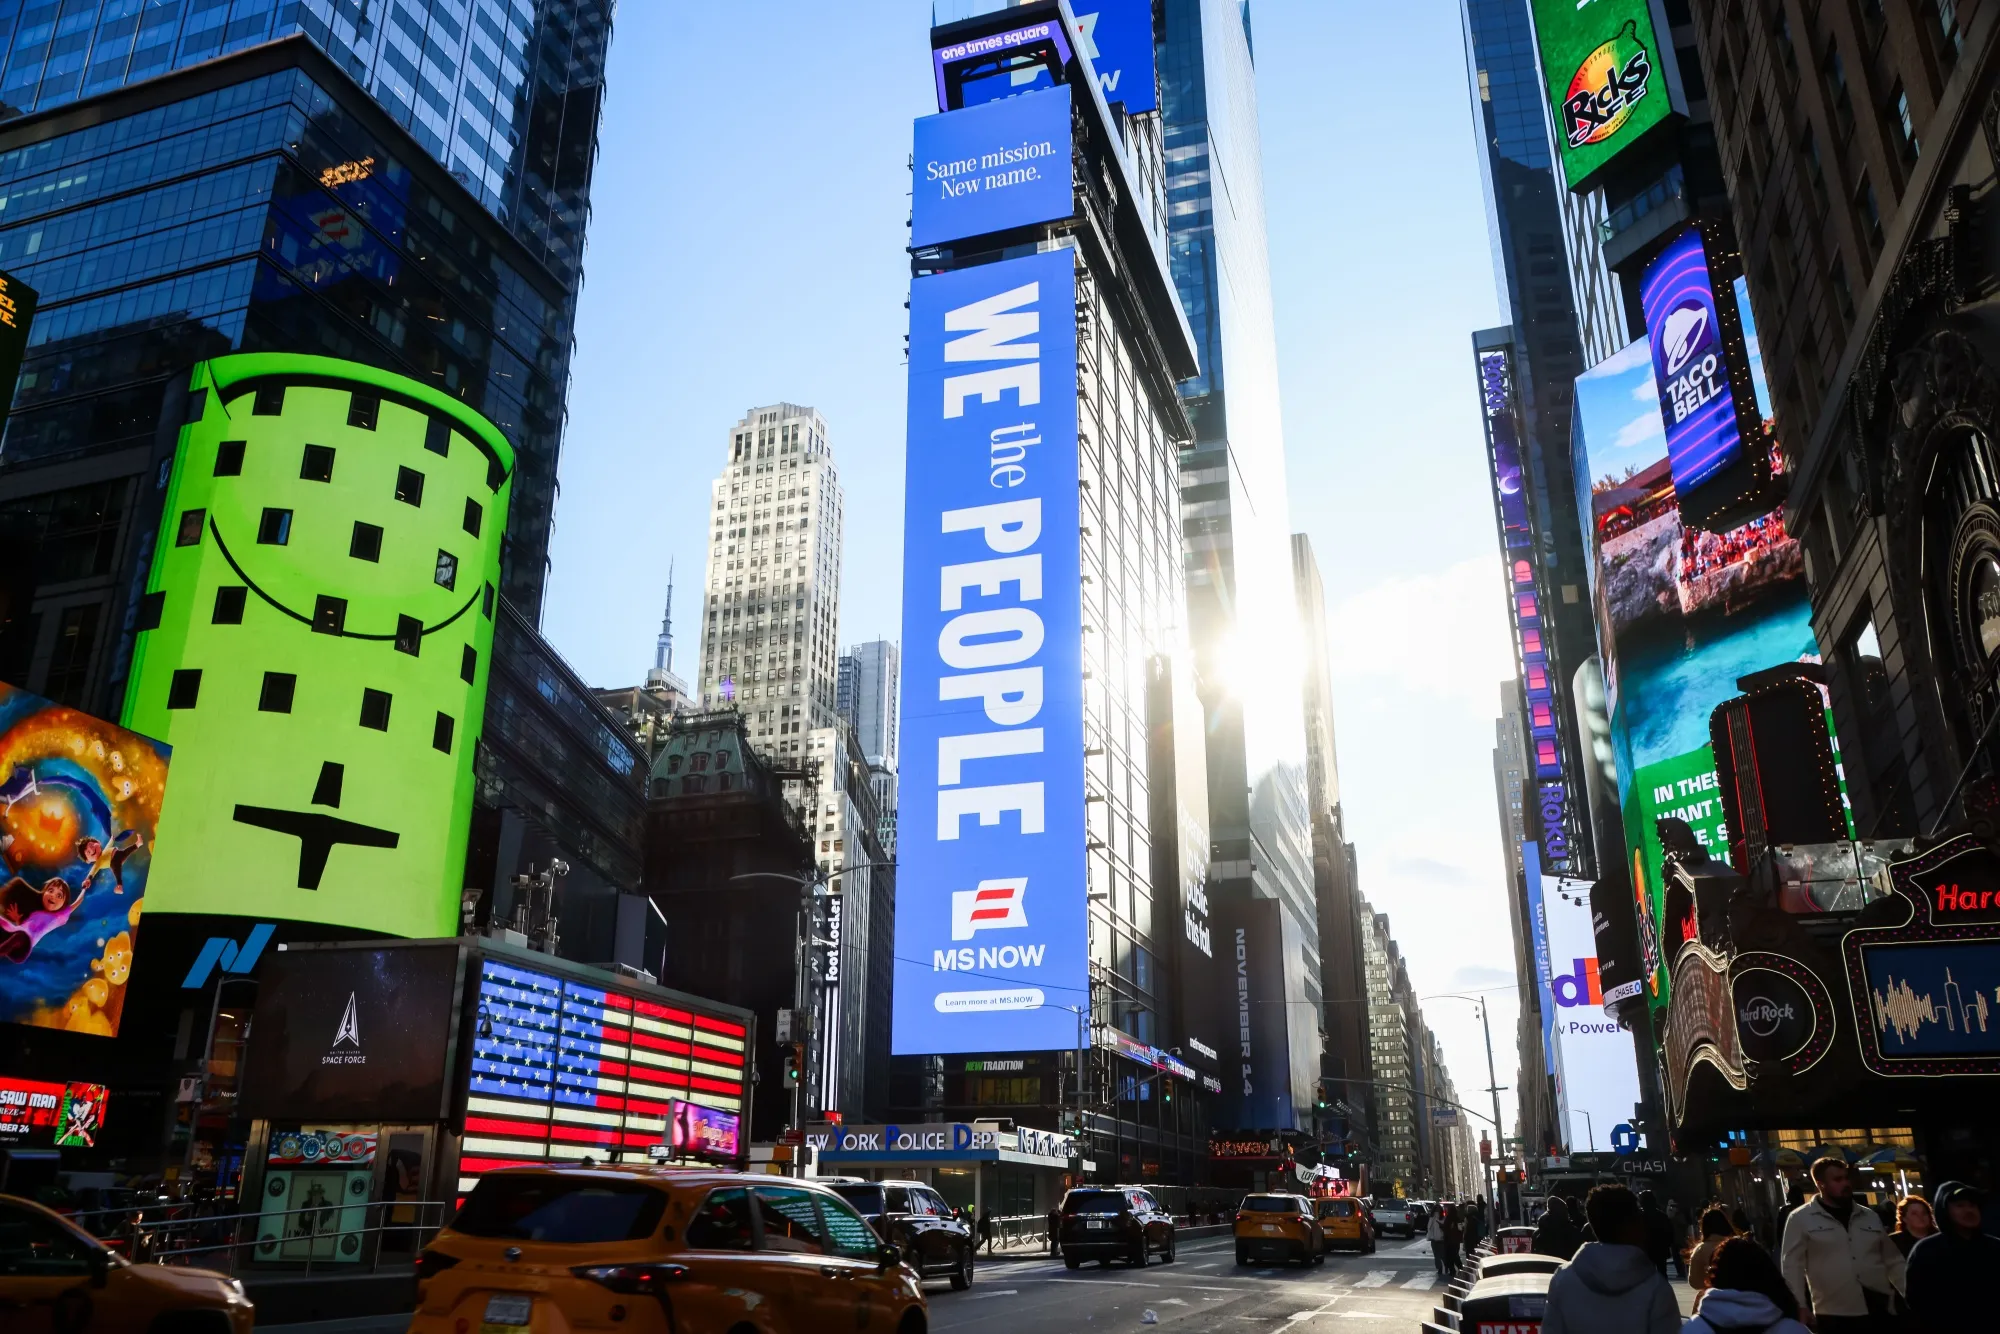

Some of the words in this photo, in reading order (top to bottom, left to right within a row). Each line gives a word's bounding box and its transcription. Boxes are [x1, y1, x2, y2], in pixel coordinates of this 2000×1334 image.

[941, 44, 966, 61] one
[966, 34, 1003, 54] times
[1003, 24, 1049, 47] square
[926, 156, 977, 181] Same
[981, 139, 1057, 170] mission.
[940, 178, 980, 200] New
[985, 165, 1042, 191] name.
[943, 281, 1040, 419] WE
[1481, 354, 1506, 410] ROKU
[1666, 352, 1718, 402] TACO
[1672, 376, 1722, 425] BELL
[989, 420, 1041, 489] the
[937, 496, 1045, 842] PEOPLE
[1653, 783, 1674, 804] IN
[1676, 769, 1722, 797] THES
[1539, 784, 1568, 858] ROKU
[1186, 848, 1193, 872] to
[1193, 852, 1206, 885] the
[1186, 877, 1209, 917] public.
[829, 897, 841, 948] Locker
[1185, 910, 1199, 947] this
[1199, 920, 1212, 958] fall.
[826, 950, 838, 982] Foot
[933, 948, 975, 972] MS
[979, 943, 1046, 970] NOW
[945, 999, 967, 1007] Learn
[968, 998, 988, 1006] more
[999, 995, 1034, 1005] MS.NOW
[1236, 928, 1251, 1057] NOVEMBER
[1614, 984, 1634, 998] CHASE
[1740, 1005, 1760, 1023] Hard
[1760, 1003, 1795, 1022] Rock
[321, 1056, 343, 1064] SPACE
[344, 1055, 366, 1064] FORCE
[1242, 1064, 1253, 1097] 14
[28, 1092, 57, 1109] MAN
[19, 1124, 30, 1134] 24
[805, 1133, 830, 1151] EW
[831, 1125, 879, 1151] YORK
[885, 1125, 945, 1150] POLICE
[1019, 1127, 1035, 1154] NEW
[1034, 1131, 1050, 1157] YORK
[1049, 1133, 1068, 1159] POLICE
